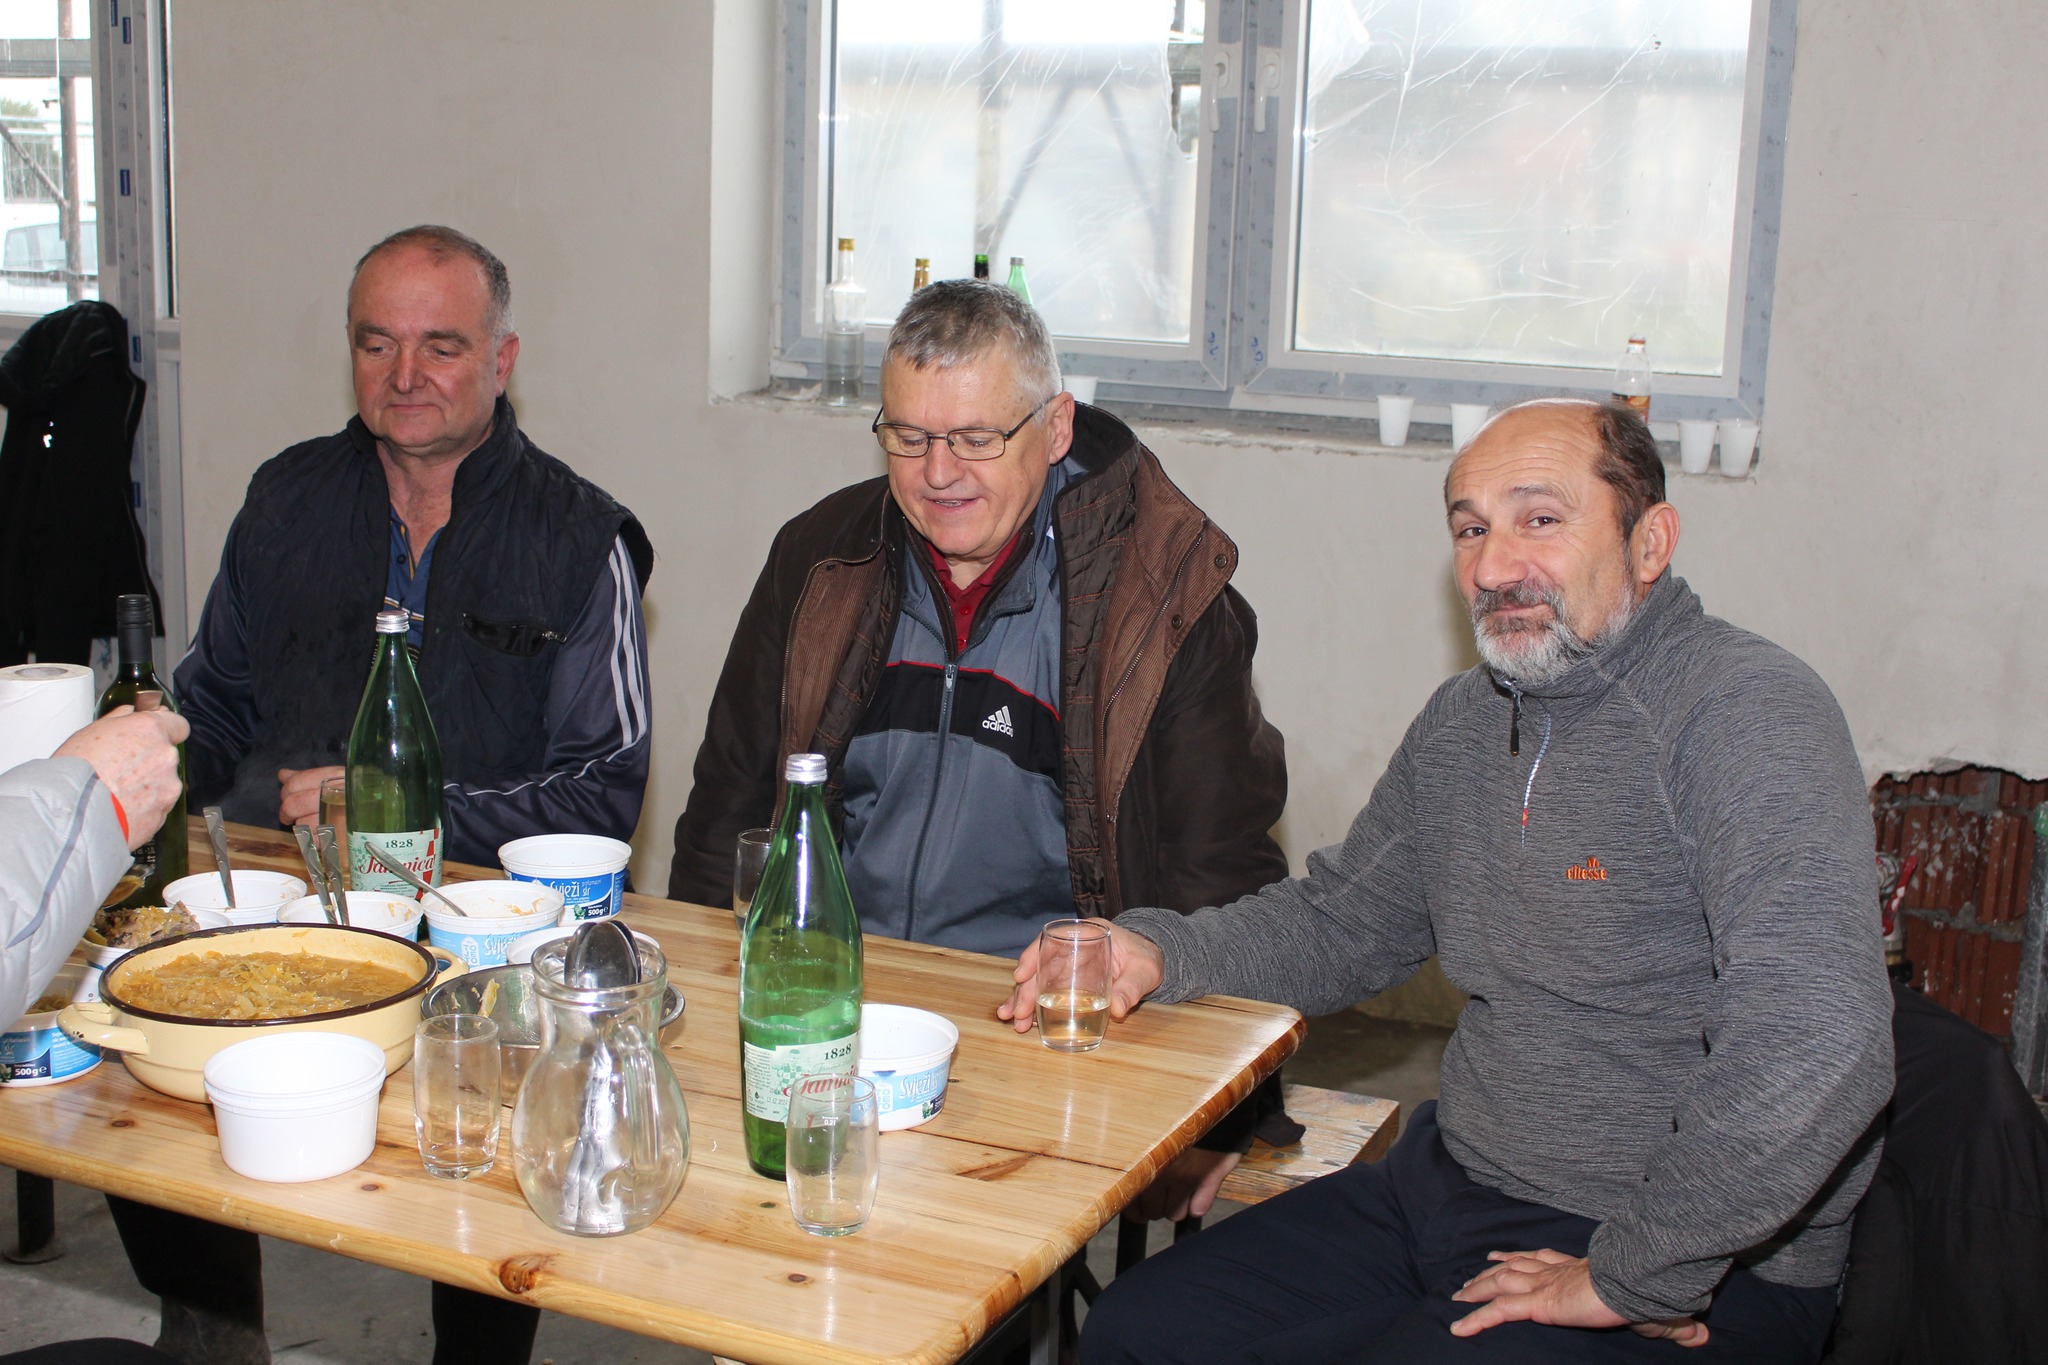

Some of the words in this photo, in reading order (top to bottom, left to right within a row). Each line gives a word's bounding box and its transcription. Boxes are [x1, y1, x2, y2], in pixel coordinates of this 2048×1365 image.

[982, 720, 1014, 738] adidas
[385, 839, 413, 849] 1828
[360, 854, 436, 875] Janica
[1565, 865, 1608, 881] ellesse
[587, 907, 603, 917] 500g
[824, 1043, 852, 1060] 1828
[15, 1067, 39, 1077] 500g
[899, 1072, 932, 1102] Svježi
